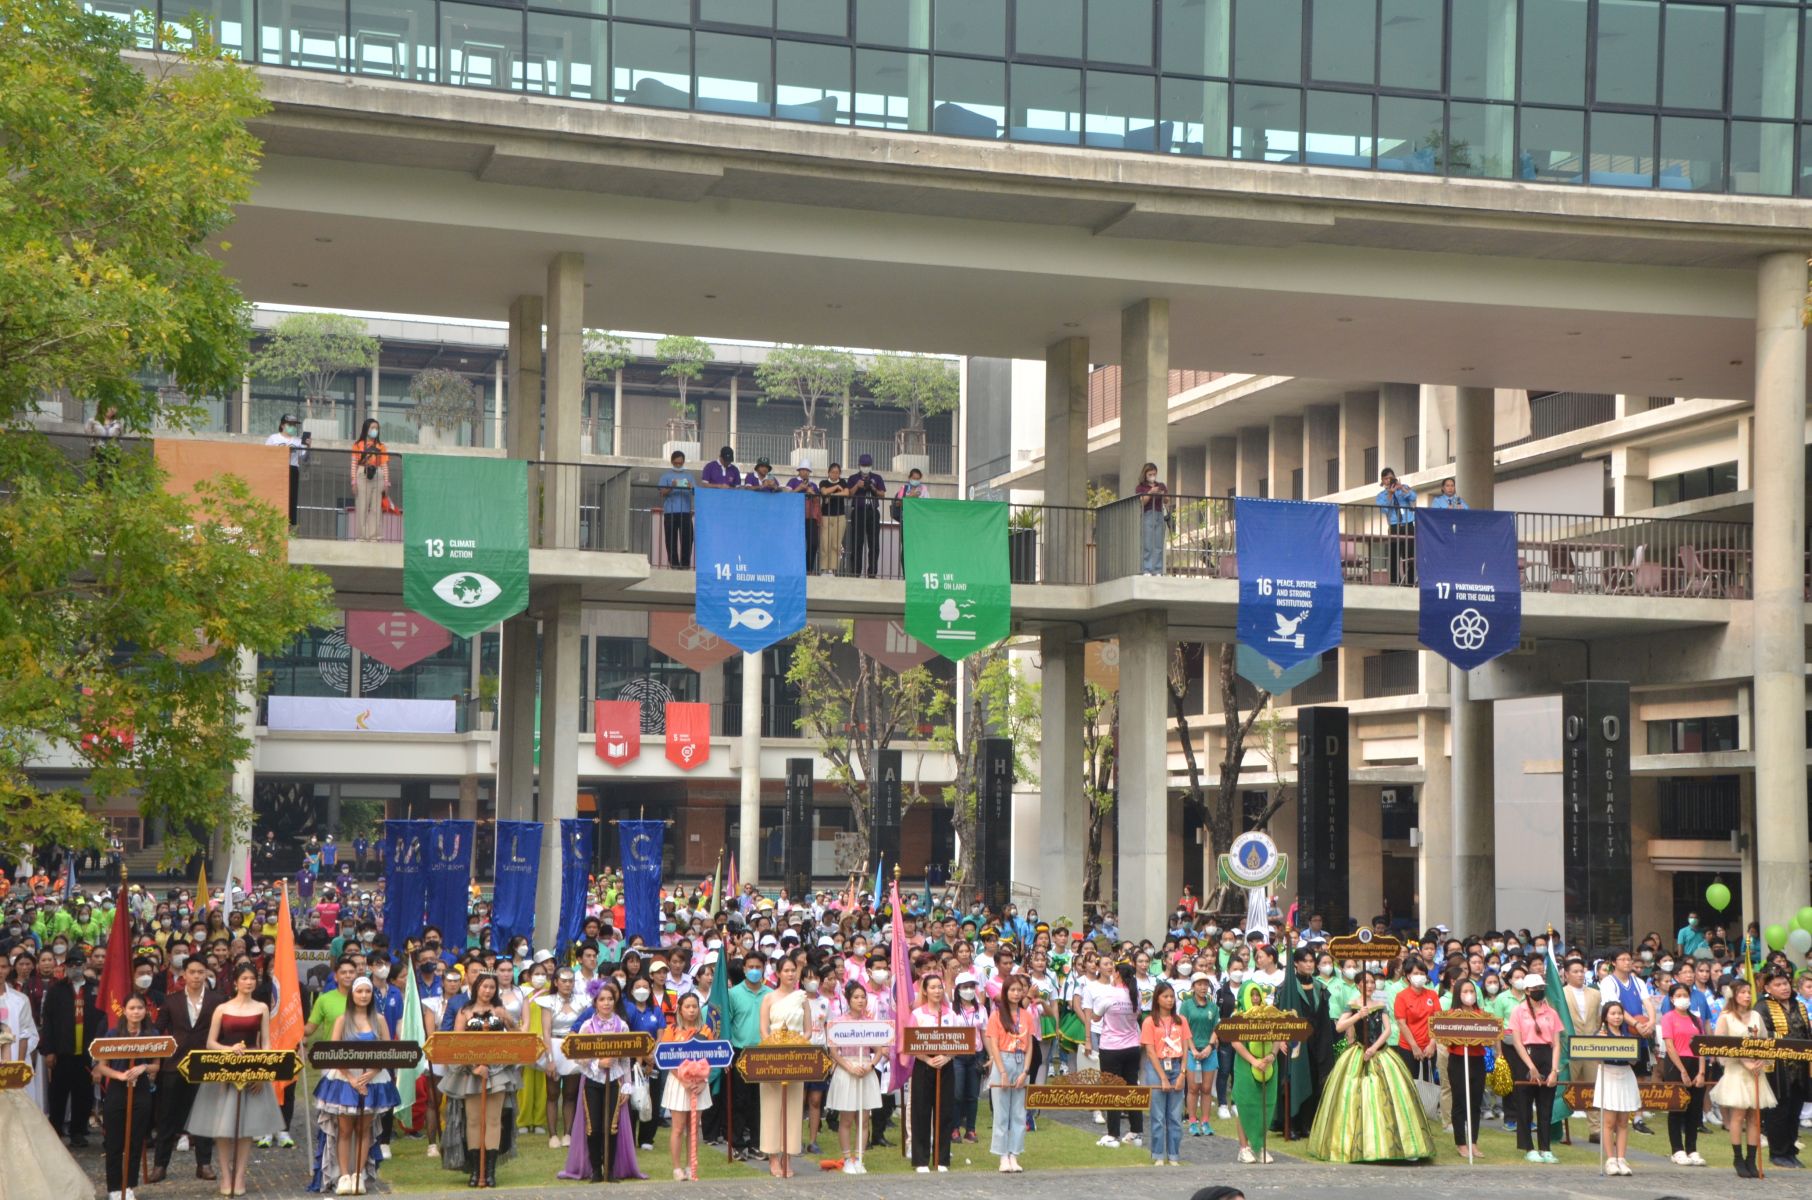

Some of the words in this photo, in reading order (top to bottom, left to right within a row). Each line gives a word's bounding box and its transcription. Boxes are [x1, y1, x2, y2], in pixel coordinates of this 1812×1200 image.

[425, 538, 444, 558] 13
[449, 540, 476, 548] CLIMATE
[449, 550, 473, 558] ACTION
[714, 563, 731, 581] 14
[736, 574, 754, 582] BELOW
[756, 574, 775, 583] WATER
[922, 573, 939, 590] 15
[953, 583, 967, 591] LAND
[1256, 578, 1272, 596] 16
[1276, 578, 1294, 588] PEACE,
[1296, 580, 1317, 589] JUSTICE
[1455, 583, 1495, 592] PARTNERSHIPS
[1276, 589, 1288, 597] AND
[1289, 590, 1311, 598] STRONG
[1435, 582, 1450, 600] 17
[1456, 592, 1466, 600] FOR
[1468, 592, 1477, 601] THE
[1478, 594, 1496, 602] GOALS
[1276, 599, 1313, 608] INSTITUTIONS
[438, 834, 460, 862] U
[834, 1030, 889, 1038] คณะศิลปศาสตร์
[1572, 1044, 1635, 1052] คณะวิทยาศาสตร์
[313, 1048, 418, 1062] สถาบันชีววิทยาศาสตร์โมเลกุล
